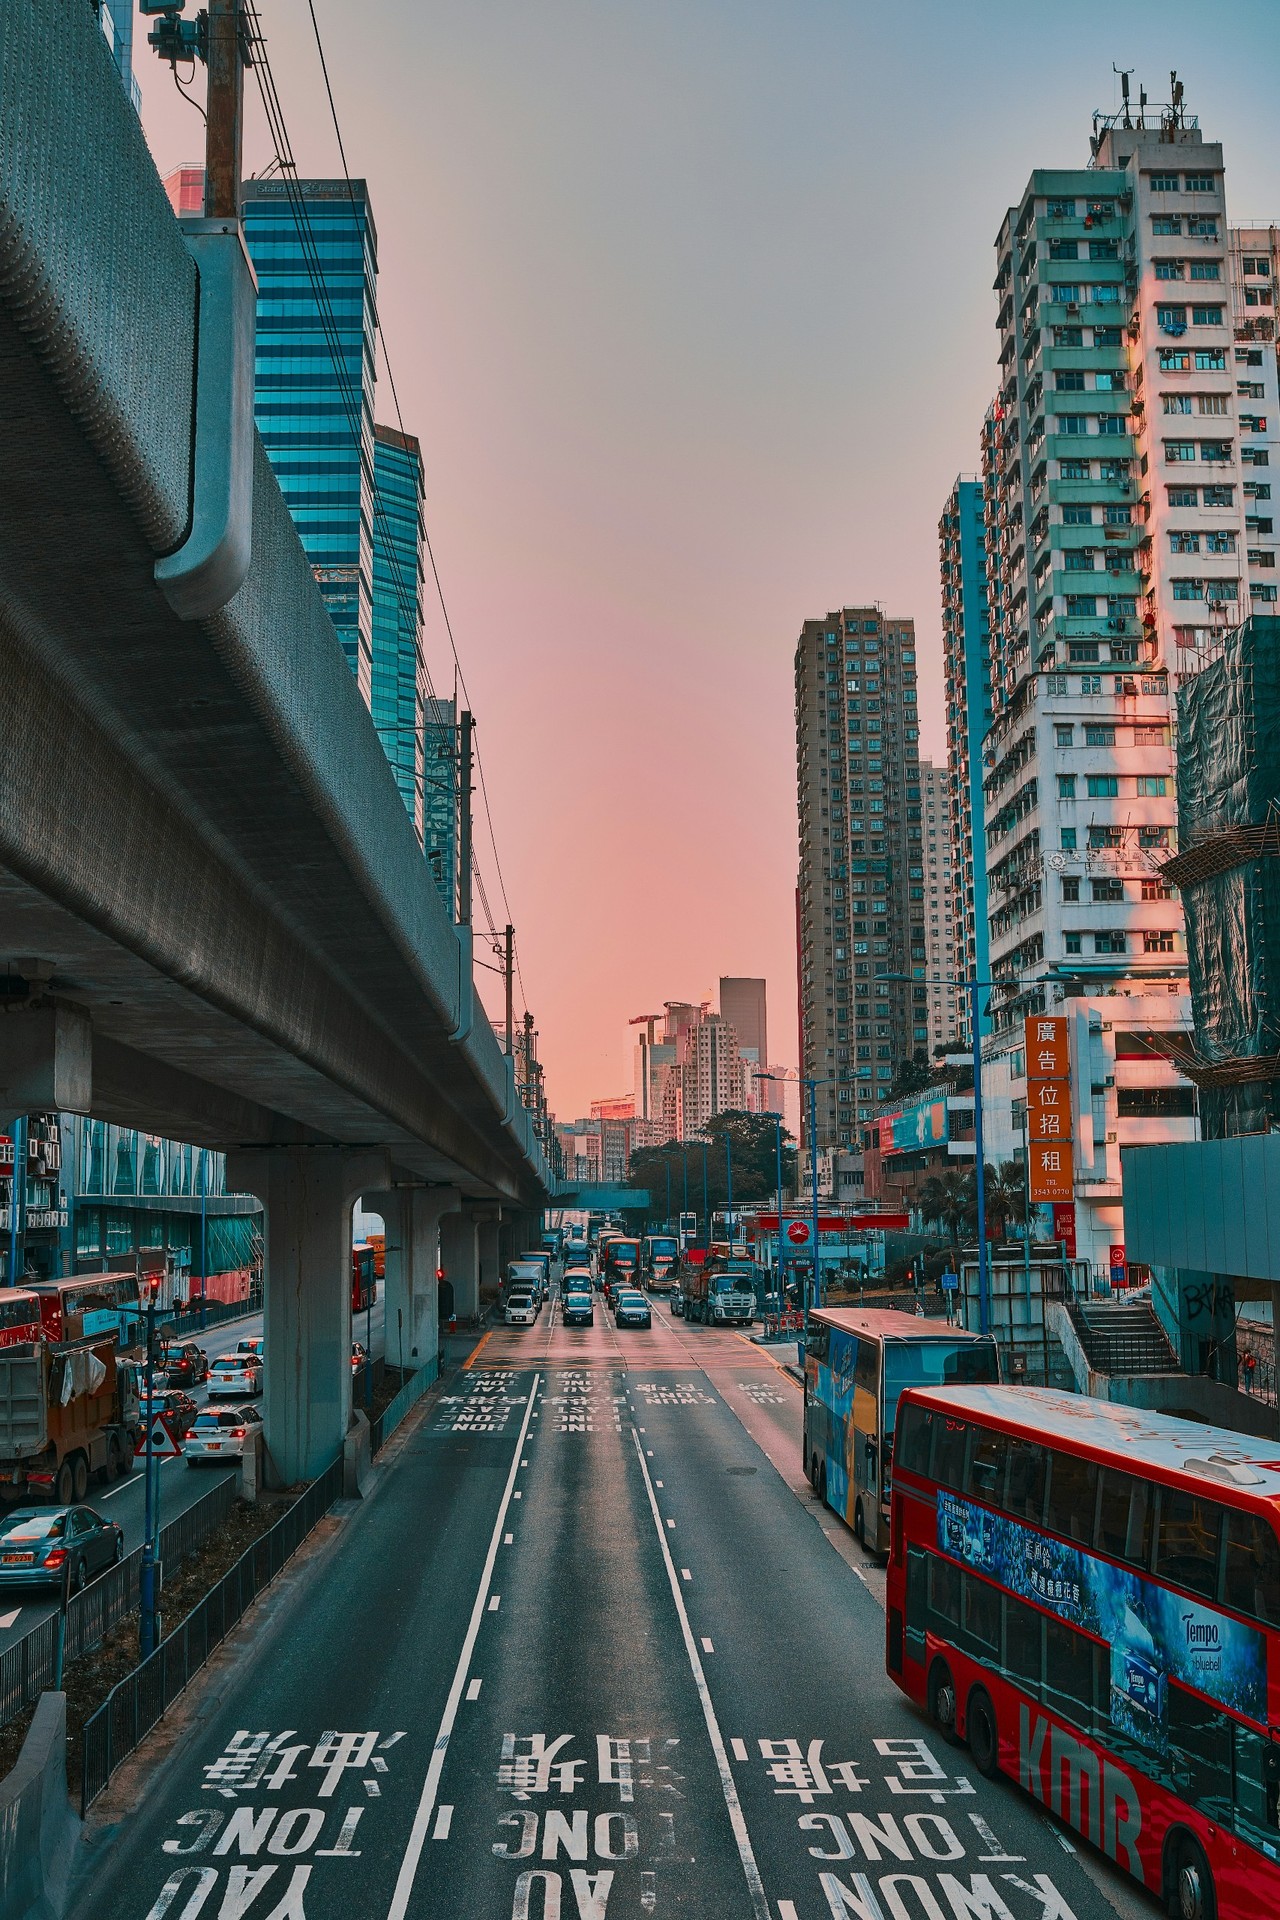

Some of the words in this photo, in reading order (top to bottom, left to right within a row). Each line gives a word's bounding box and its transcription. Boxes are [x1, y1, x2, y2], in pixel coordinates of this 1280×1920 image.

[1036, 1021, 1062, 1172] 廣告位招租
[1033, 1188, 1051, 1196] 3543
[1182, 1613, 1219, 1647] Tempo
[1195, 1656, 1222, 1671] bluebell
[200, 1730, 408, 1798] 油塘
[497, 1733, 687, 1802] 油塘
[757, 1738, 977, 1804] 官塘
[162, 1807, 365, 1857] TONG
[798, 1812, 1028, 1862] TONG
[144, 1864, 314, 1920] YAU
[818, 1872, 1080, 1920] KWUN
